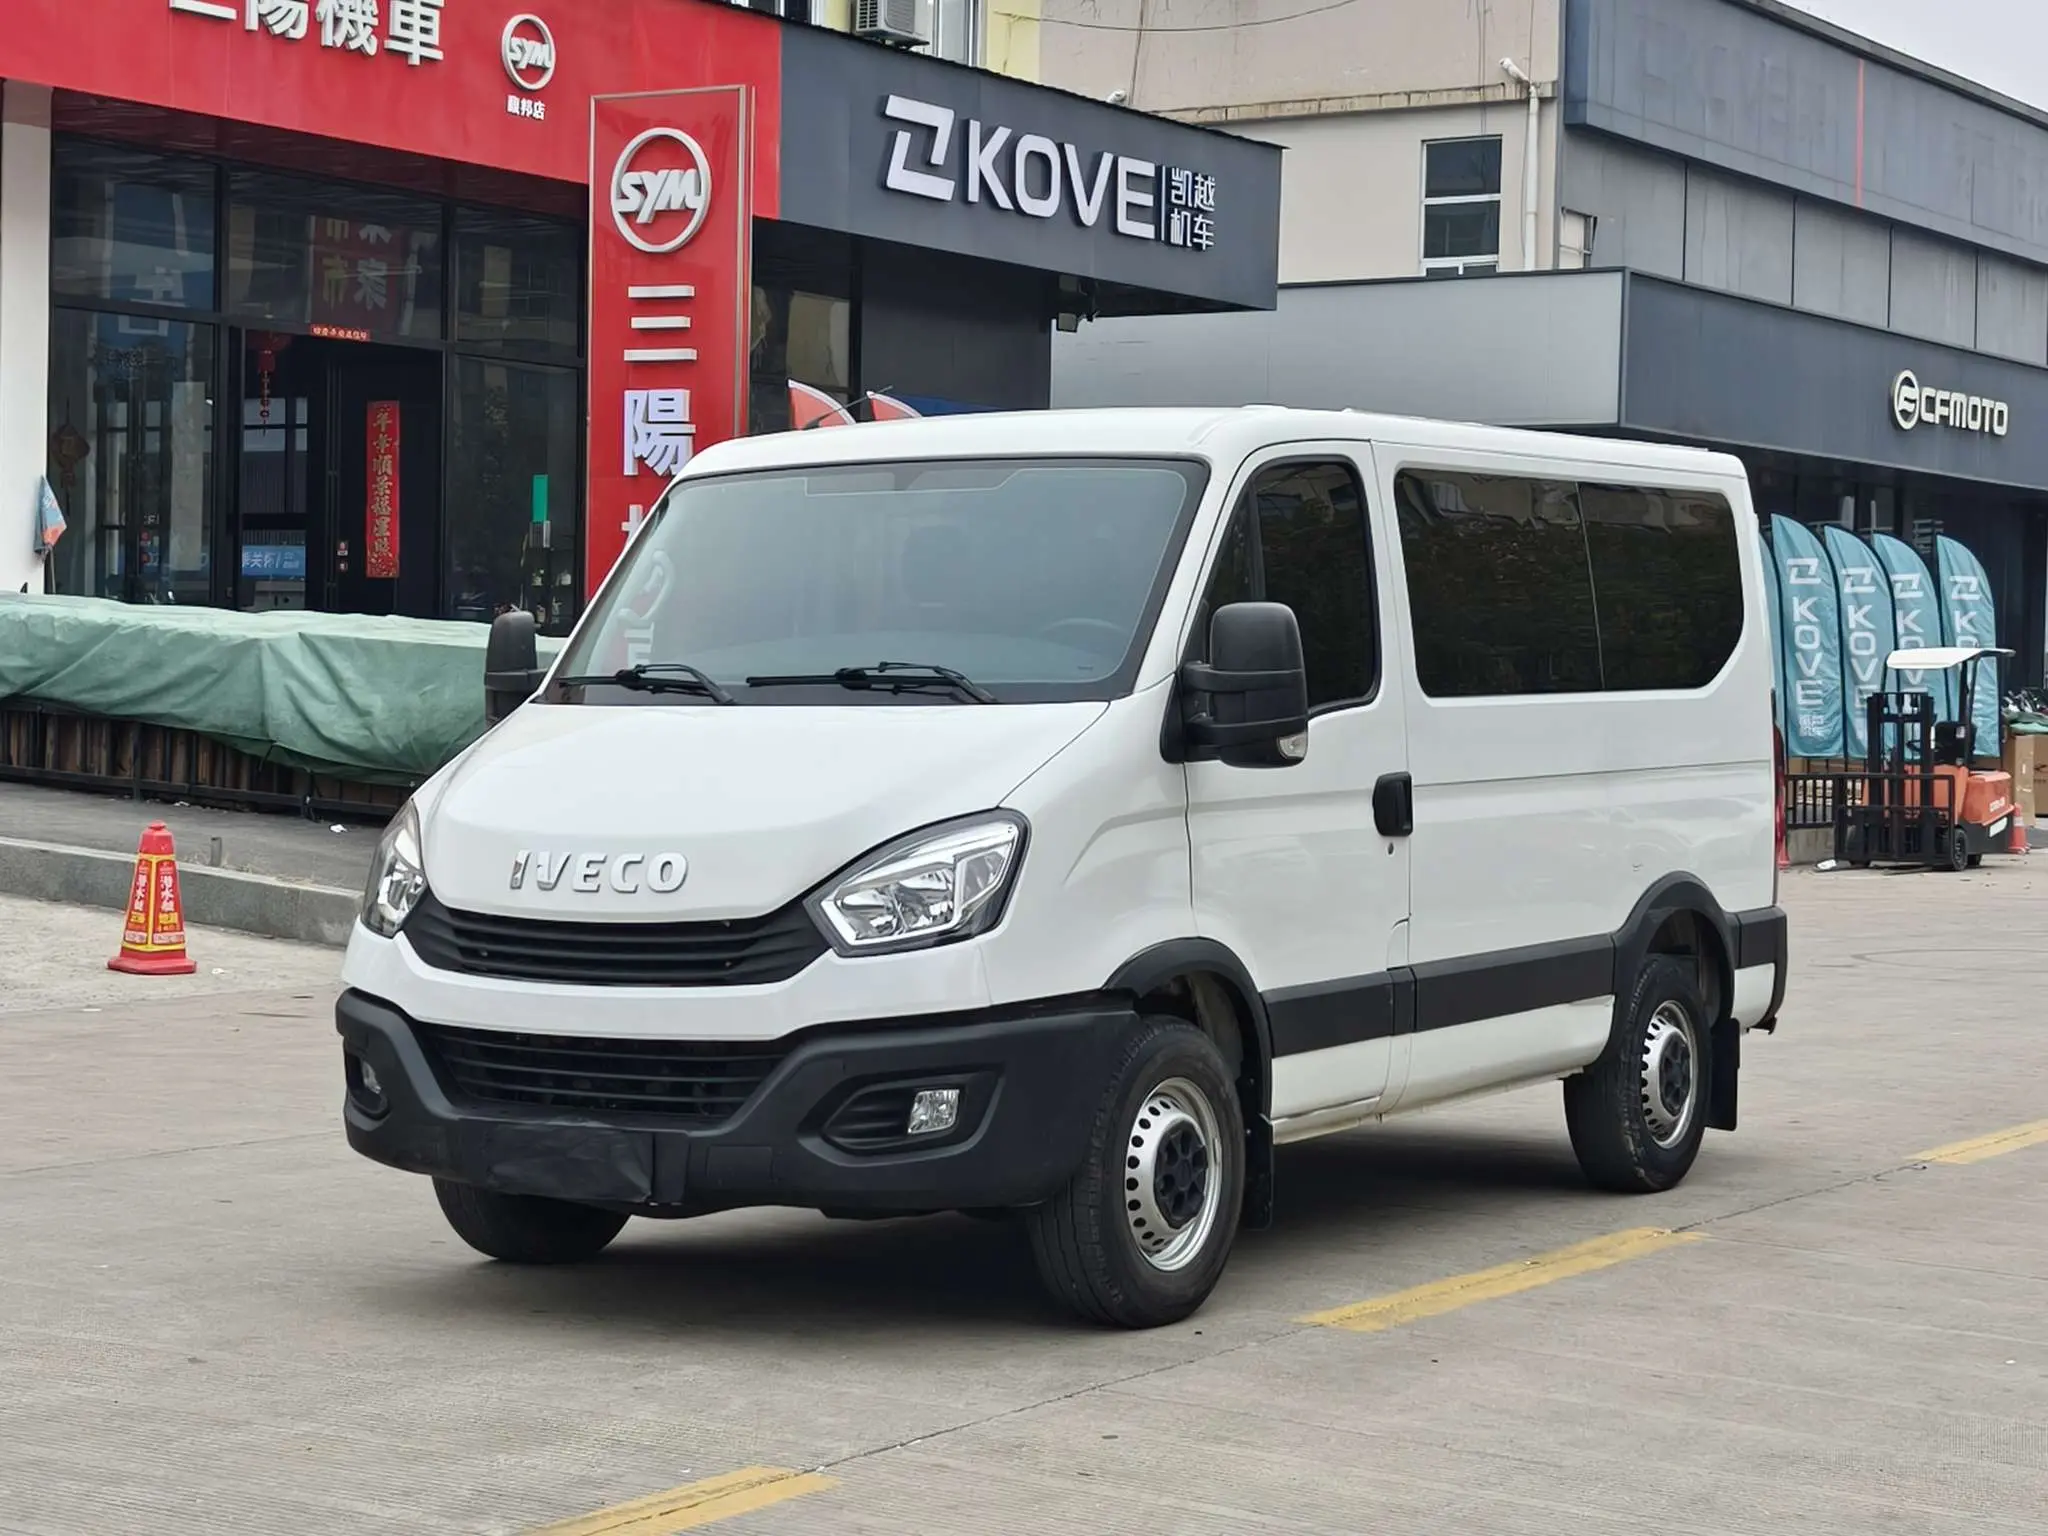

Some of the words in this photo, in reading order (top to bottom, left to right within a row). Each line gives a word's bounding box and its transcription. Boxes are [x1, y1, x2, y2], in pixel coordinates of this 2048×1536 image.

[508, 37, 551, 69] SYM
[615, 168, 703, 223] SYM
[968, 119, 1155, 239] KOVE
[1170, 167, 1216, 212] 凯越
[1170, 207, 1215, 250] 机车
[621, 285, 698, 549] 三陽
[1921, 387, 2008, 435] CFMOTO
[1792, 597, 1824, 706] KOVE
[1848, 605, 1879, 709] KOVE
[510, 850, 690, 893] IVECO
